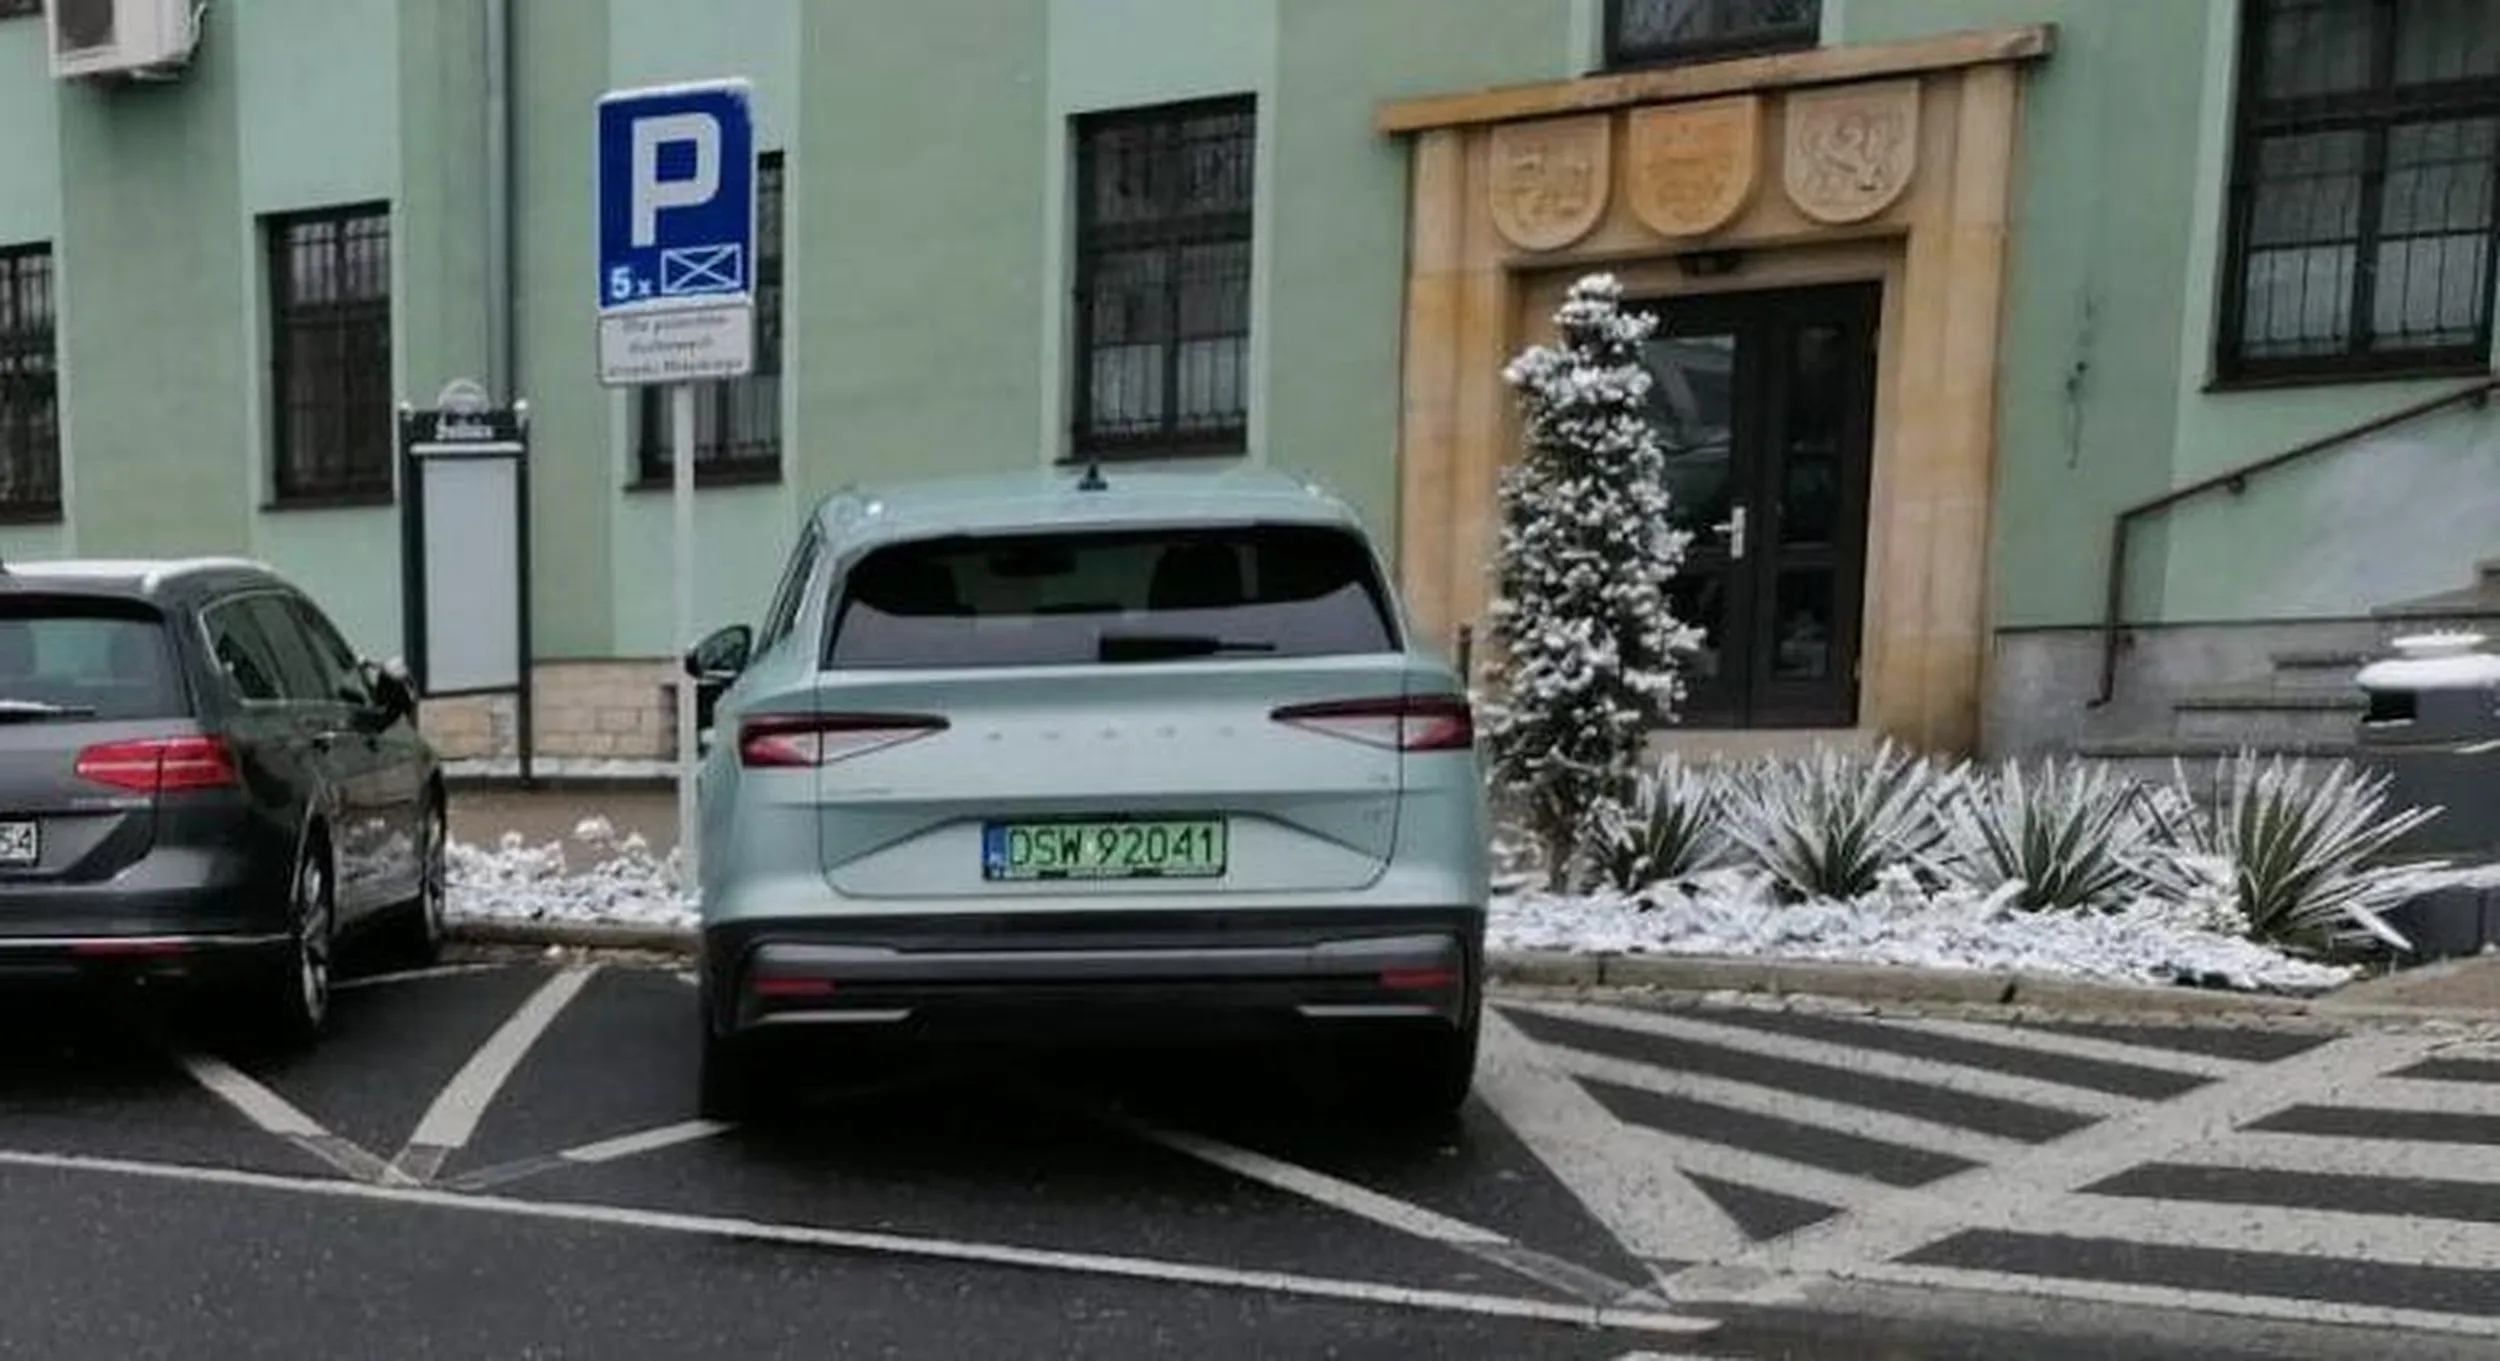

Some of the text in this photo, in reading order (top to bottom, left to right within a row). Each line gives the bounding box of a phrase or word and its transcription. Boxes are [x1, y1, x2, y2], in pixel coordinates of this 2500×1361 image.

[631, 112, 720, 247] P
[1009, 826, 1213, 866] DSW 92041
